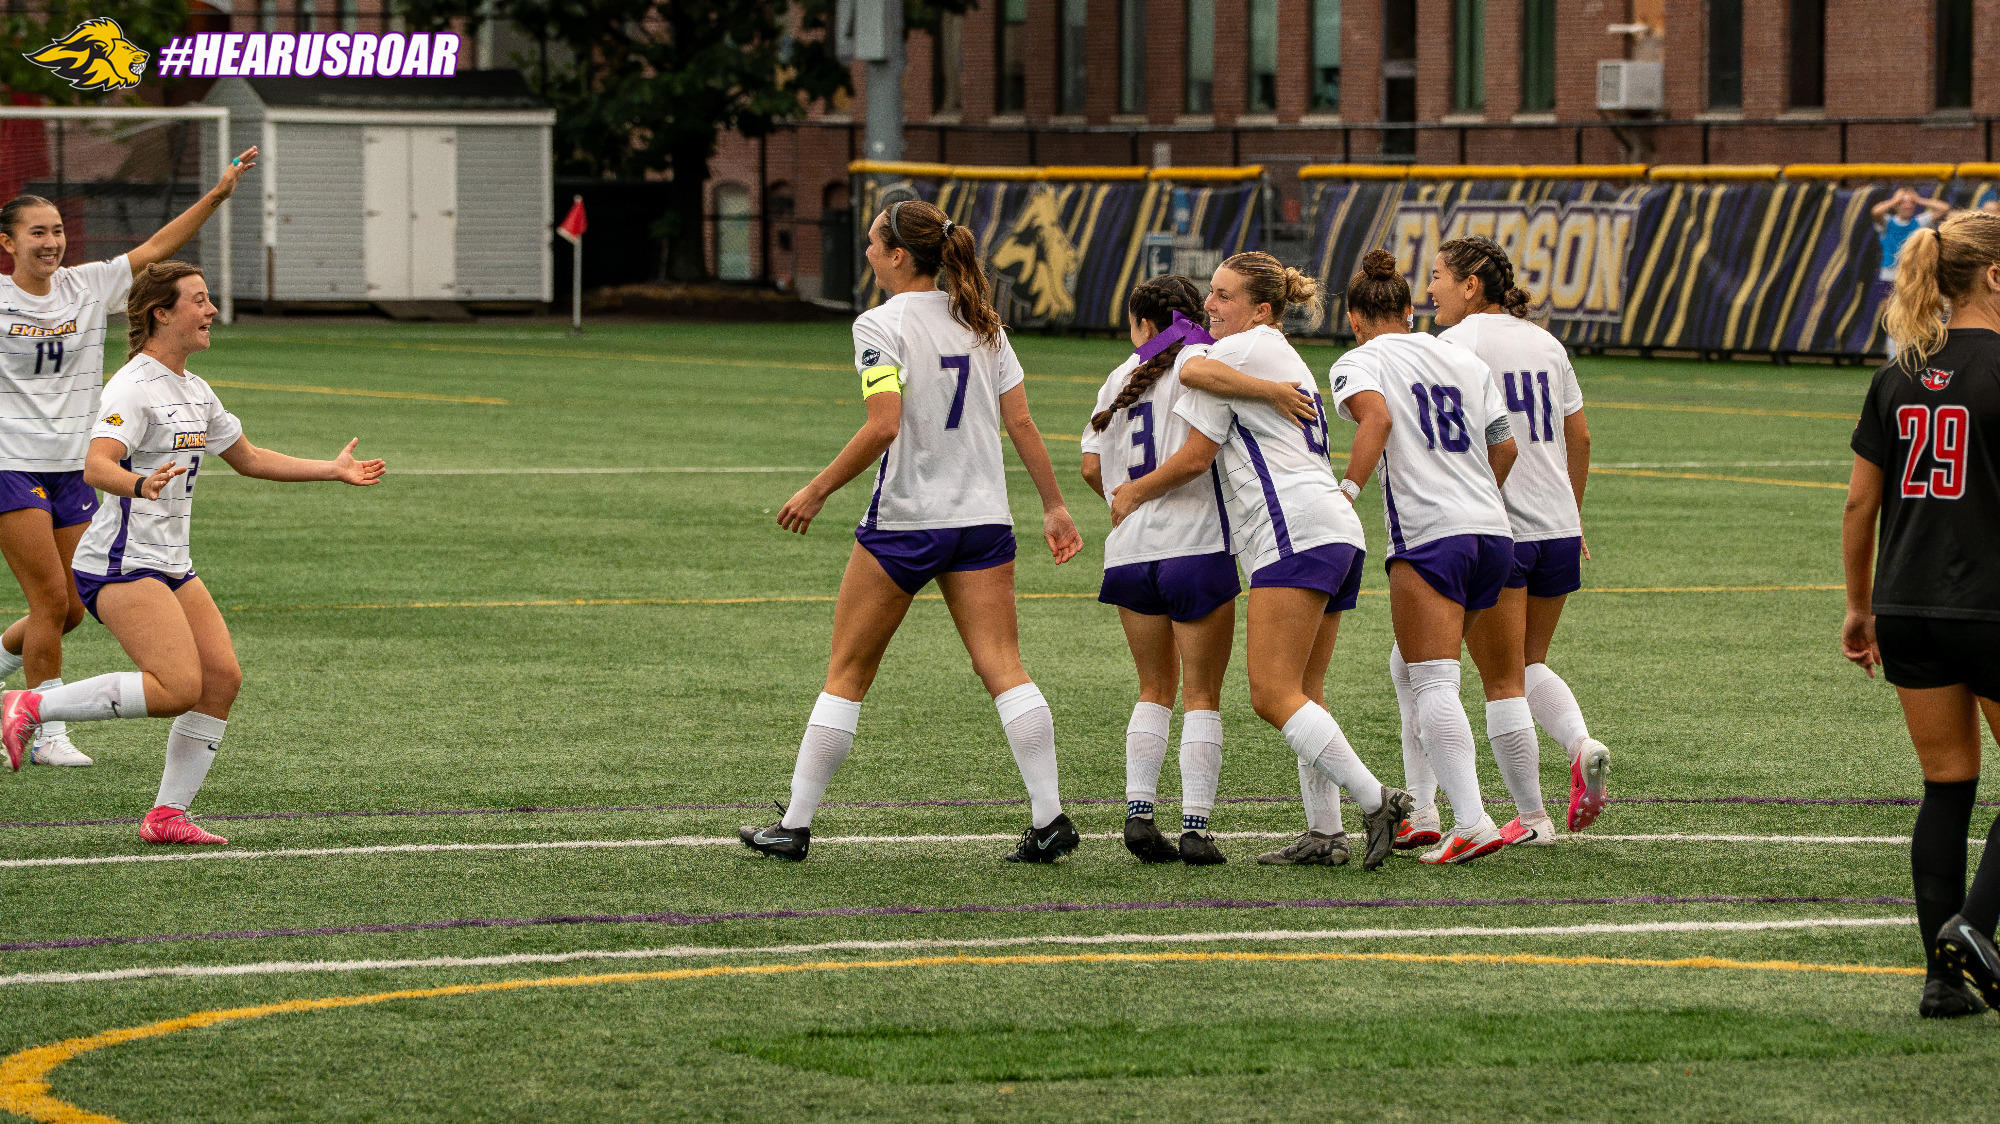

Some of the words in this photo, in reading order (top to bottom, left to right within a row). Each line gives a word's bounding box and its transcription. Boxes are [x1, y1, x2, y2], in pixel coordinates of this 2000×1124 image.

[1392, 203, 1636, 319] EMRSON
[34, 341, 63, 374] 14
[940, 354, 970, 430] 7
[172, 431, 206, 450] EMERS
[1126, 401, 1157, 479] 3
[1411, 382, 1470, 453] 18
[1503, 370, 1552, 443] 41
[186, 455, 199, 492] 2
[1896, 404, 1969, 499] 29
